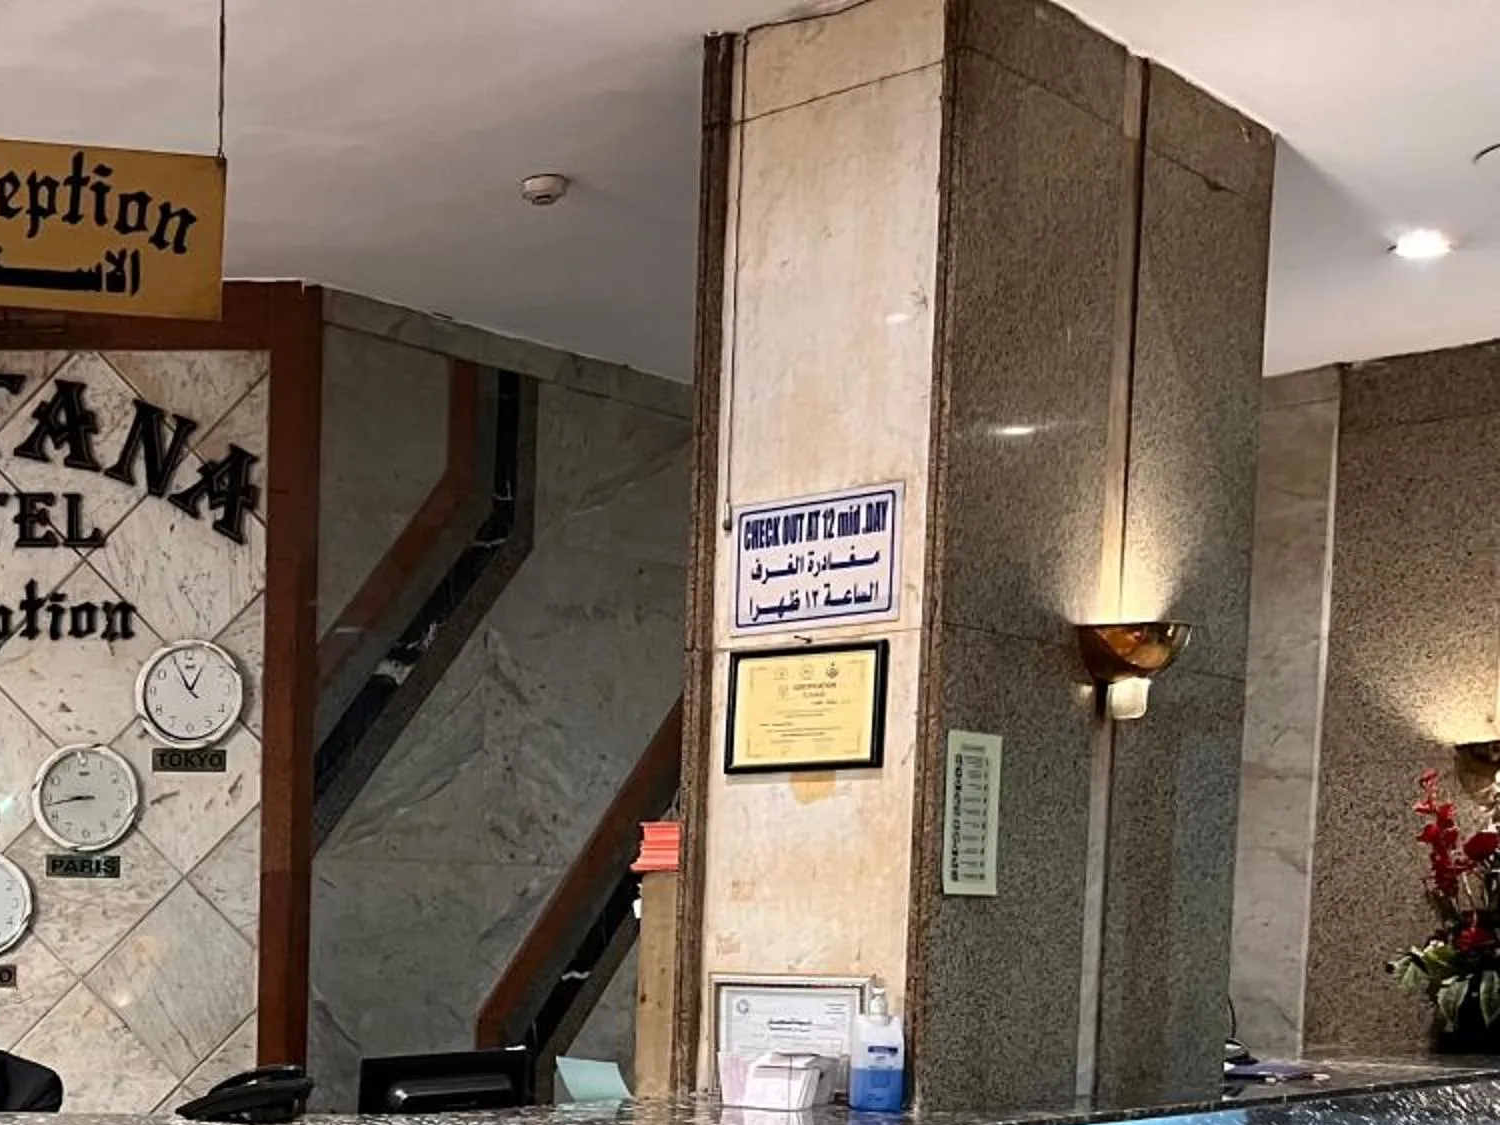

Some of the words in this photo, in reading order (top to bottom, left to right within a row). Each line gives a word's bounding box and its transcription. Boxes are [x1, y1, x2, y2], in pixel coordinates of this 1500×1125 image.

[743, 515, 781, 550] CHECK
[782, 512, 804, 545] OUT
[806, 509, 820, 542] AT
[822, 507, 835, 539] 12
[155, 752, 223, 768] TOKYO
[50, 858, 116, 873] PARIS
